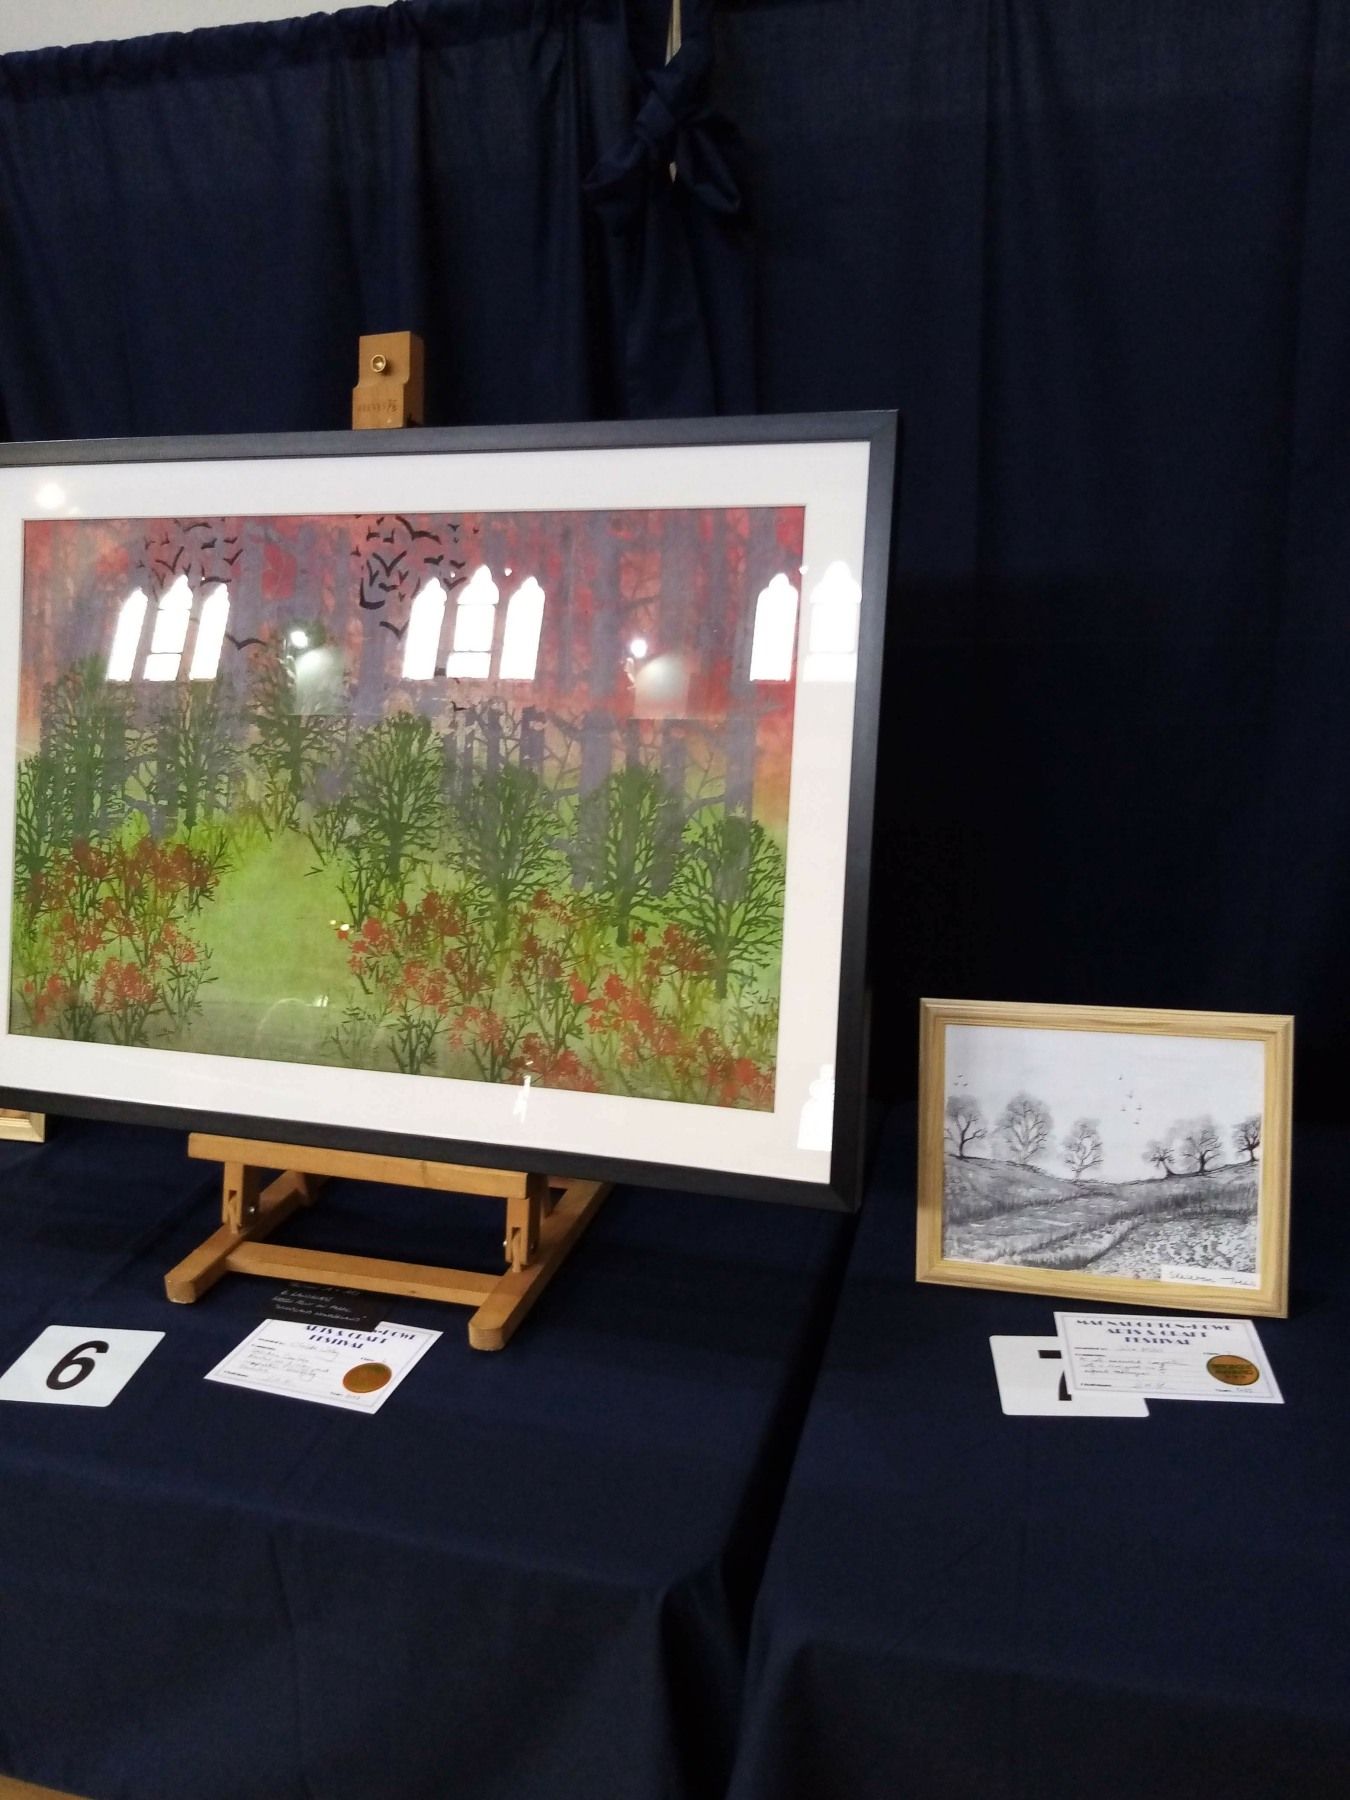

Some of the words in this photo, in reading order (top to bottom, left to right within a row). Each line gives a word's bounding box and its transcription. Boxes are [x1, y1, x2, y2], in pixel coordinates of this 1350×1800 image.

[306, 1324, 333, 1336] ARTS
[349, 1331, 390, 1345] CRAFT
[309, 1333, 365, 1350] FESTIVAL
[1106, 1327, 1139, 1337] ARTS
[1160, 1329, 1209, 1339] CRAFT
[1124, 1335, 1192, 1346] FESTIVAL
[46, 1340, 110, 1391] 6
